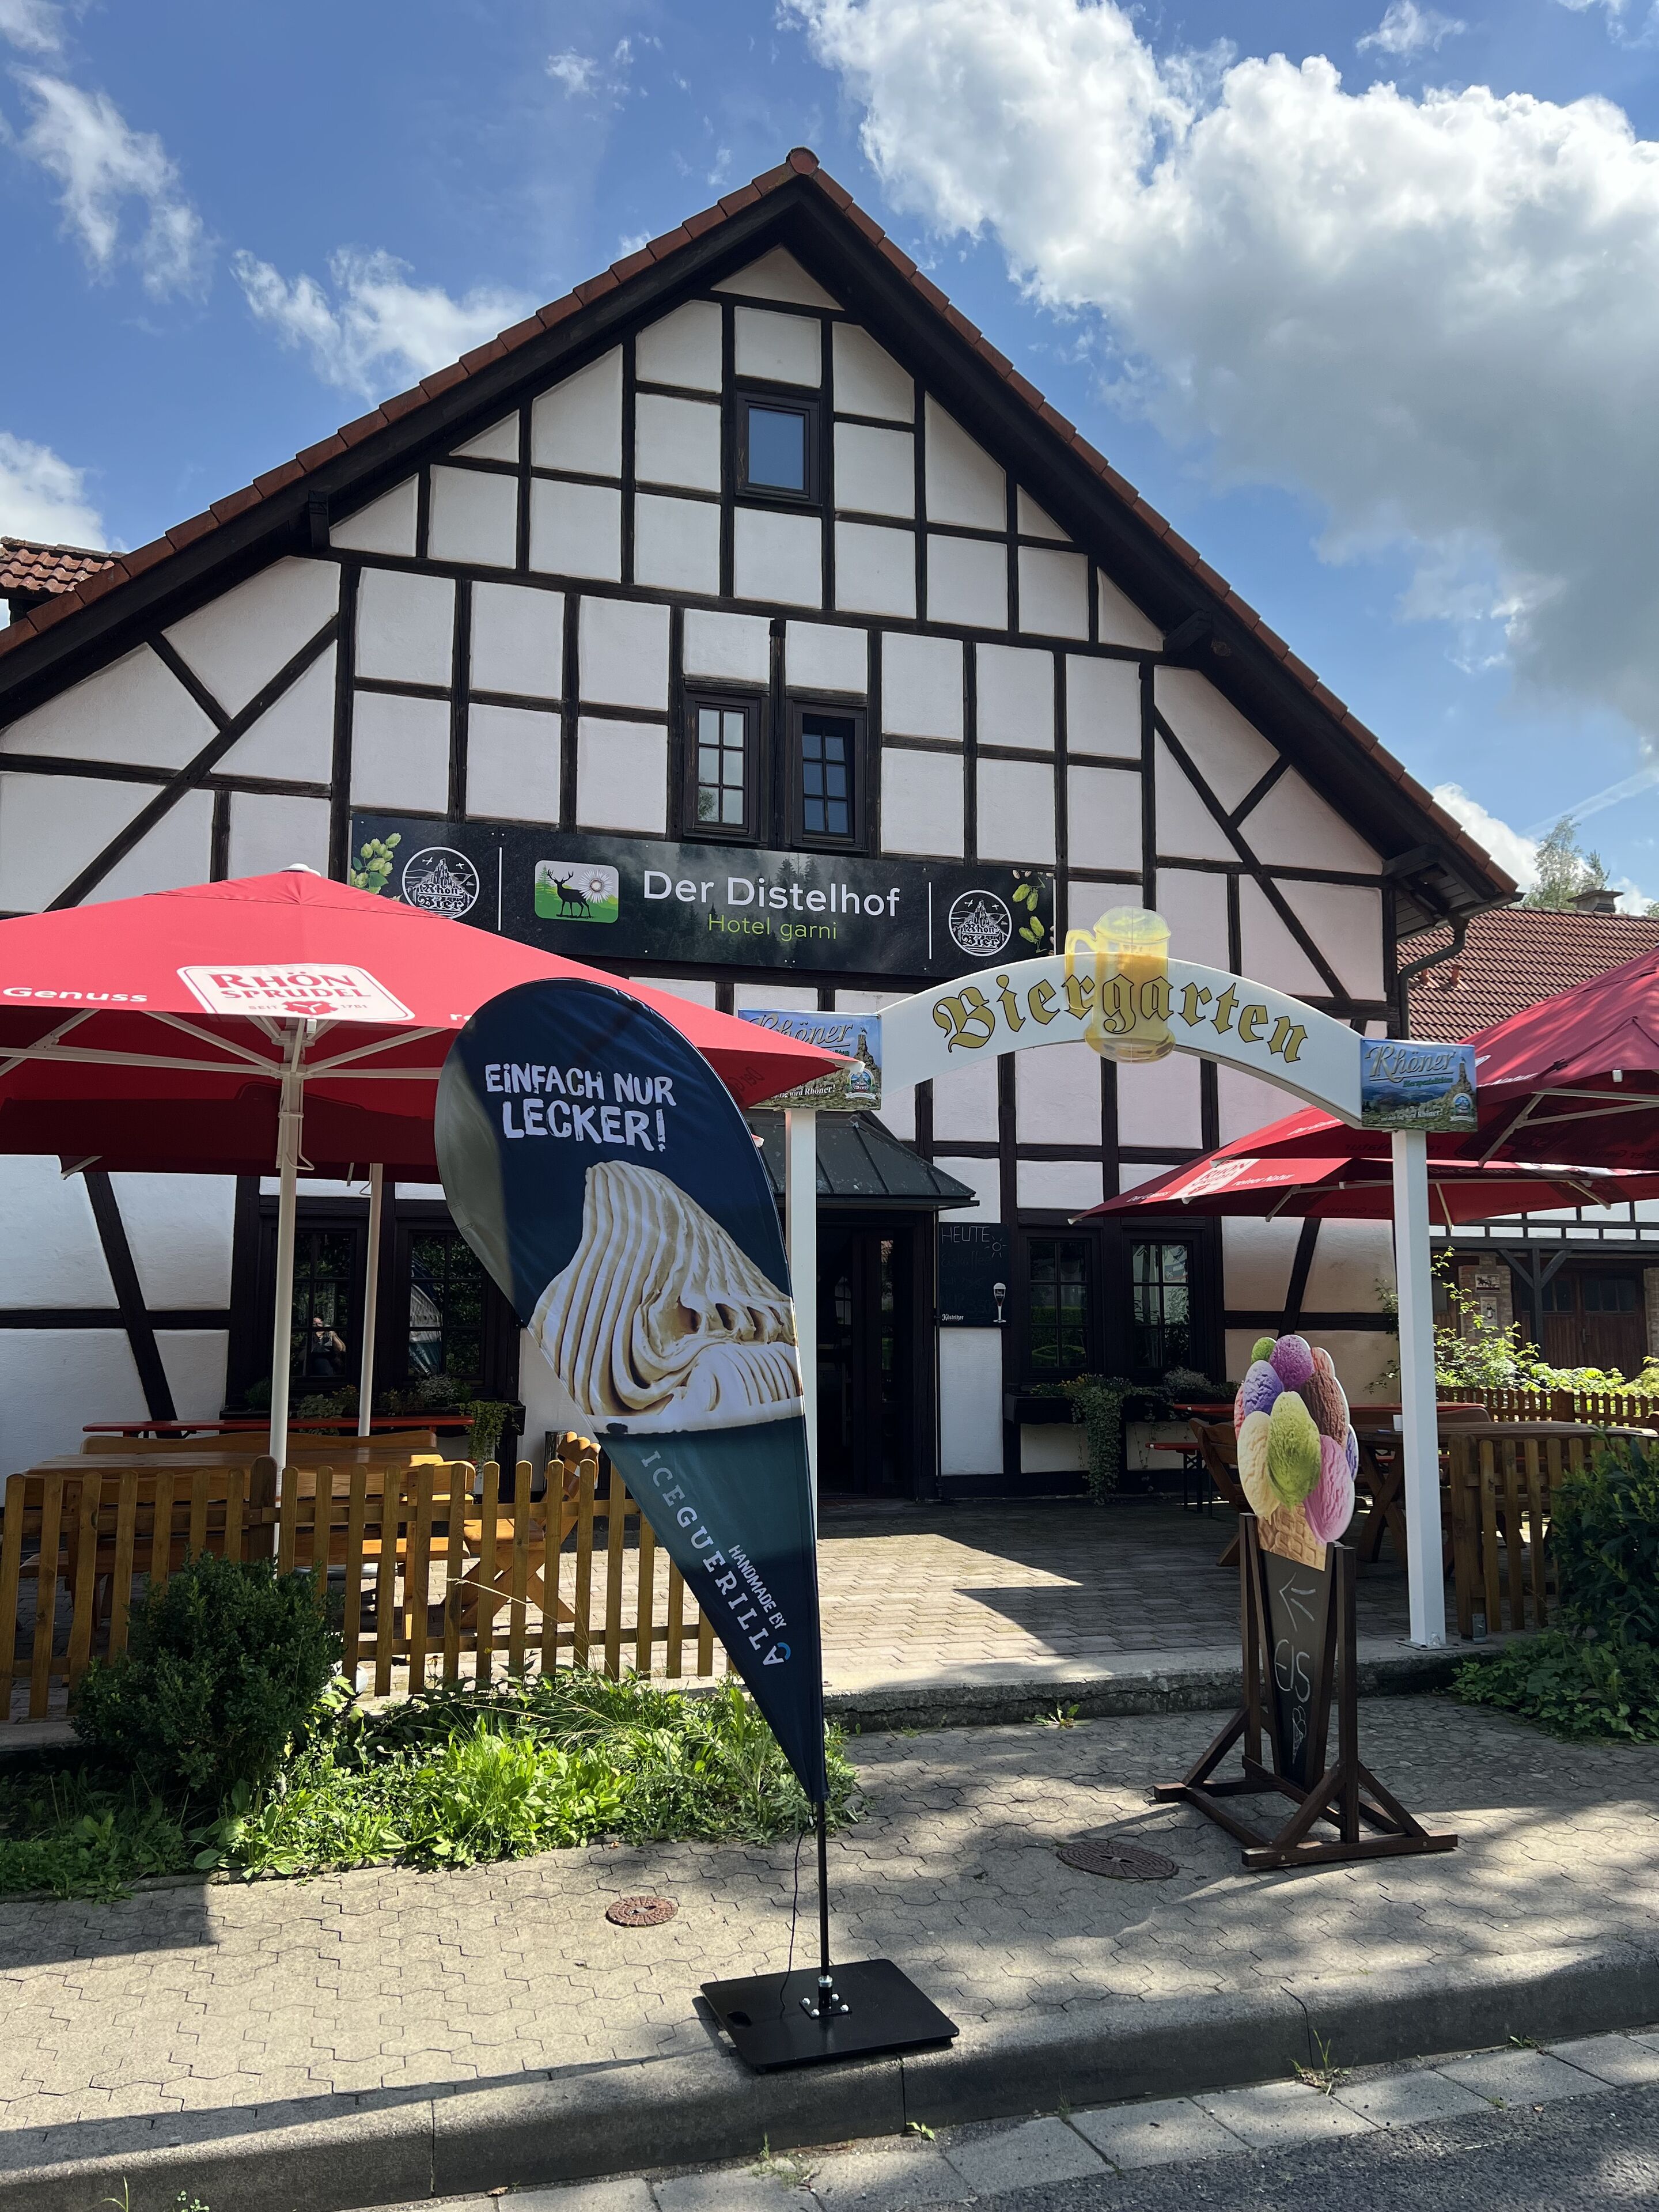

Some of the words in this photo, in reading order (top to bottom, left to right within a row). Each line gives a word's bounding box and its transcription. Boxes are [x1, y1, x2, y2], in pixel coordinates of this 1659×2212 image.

[418, 895, 464, 910] Bier
[419, 882, 461, 894] Rhön
[643, 869, 714, 903] Der
[728, 876, 900, 917] Distelhof
[708, 913, 770, 935] Hotel
[780, 921, 838, 942] garni
[962, 935, 999, 947] Bier
[963, 922, 999, 933] Rhön
[207, 971, 358, 989] RHÖN
[221, 987, 372, 999] SPRUDEL
[2, 987, 148, 1003] Genuss
[932, 974, 1309, 1063] Biergarten
[1365, 1043, 1457, 1084] Rhöner
[613, 1073, 677, 1107] NUR
[502, 1098, 666, 1153] LECKER!
[941, 1226, 990, 1243] HEUTE
[641, 1450, 785, 1666] ICEGUERILLA
[728, 1544, 777, 1613] HANDMADE
[768, 1611, 787, 1630] BY
[1274, 1639, 1310, 1704] EIS
